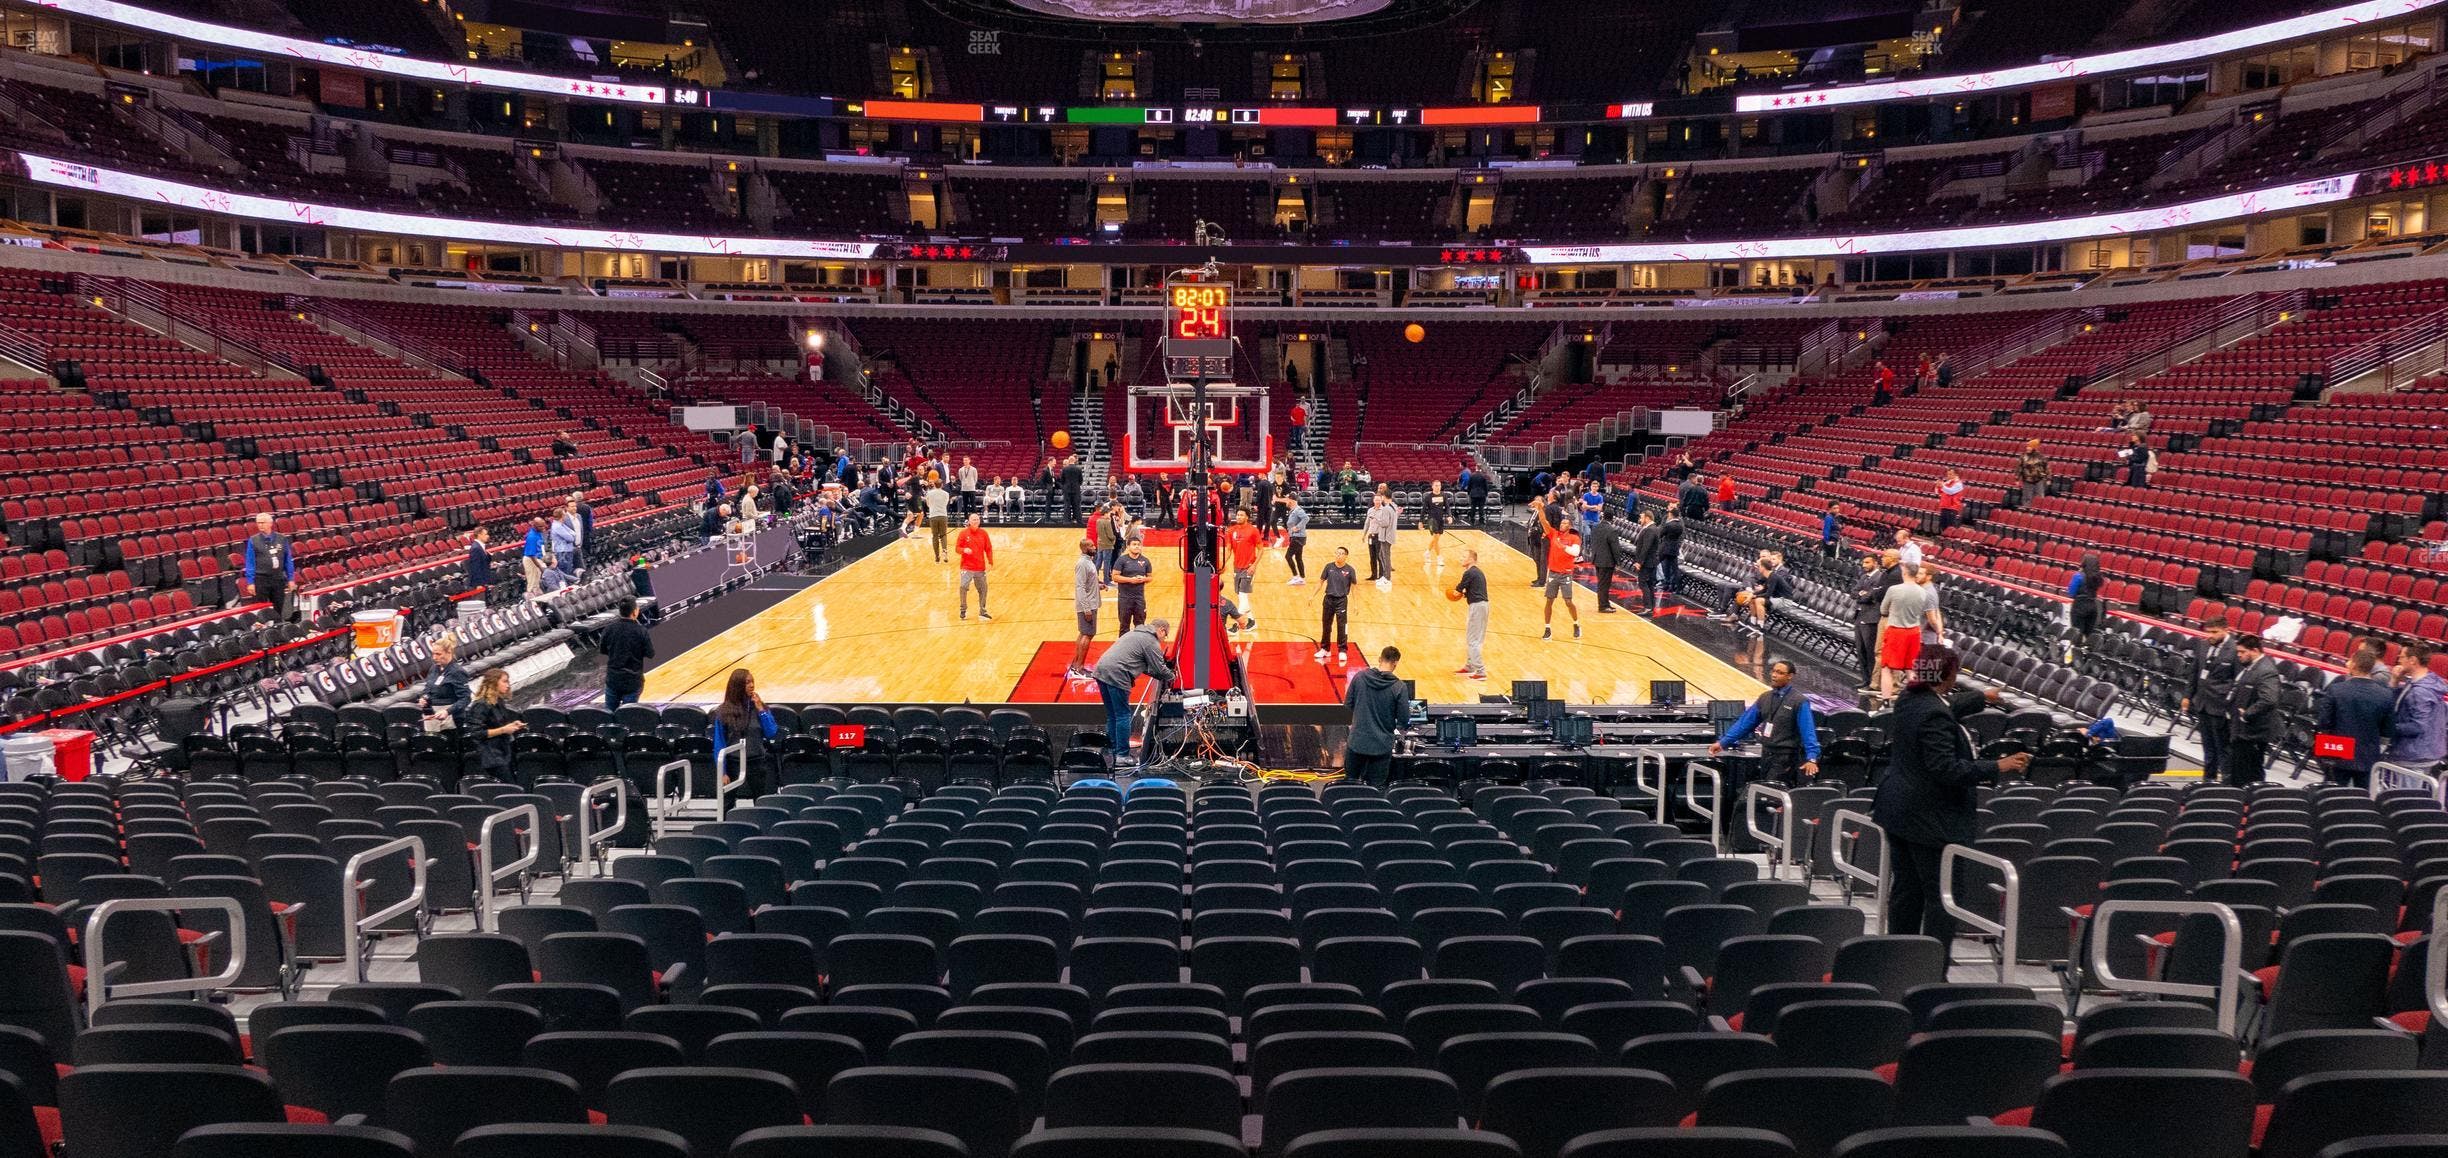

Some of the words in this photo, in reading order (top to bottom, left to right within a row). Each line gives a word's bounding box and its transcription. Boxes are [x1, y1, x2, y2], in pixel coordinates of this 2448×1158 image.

[1622, 103, 1641, 117] WITH
[1641, 102, 1654, 116] US
[1176, 288, 1224, 307] 82:07
[1181, 308, 1219, 336] 24
[506, 608, 519, 626] G
[519, 604, 531, 621] G
[531, 600, 543, 618] G
[469, 621, 482, 640] G
[481, 617, 494, 635] G
[491, 613, 506, 631] G
[456, 625, 469, 644] G
[394, 645, 409, 664] G
[410, 640, 425, 660] G
[360, 657, 377, 677] G
[378, 652, 394, 672] G
[318, 670, 336, 692] G
[340, 663, 357, 684] G
[839, 732, 856, 740] 117
[2324, 743, 2344, 751] 116
